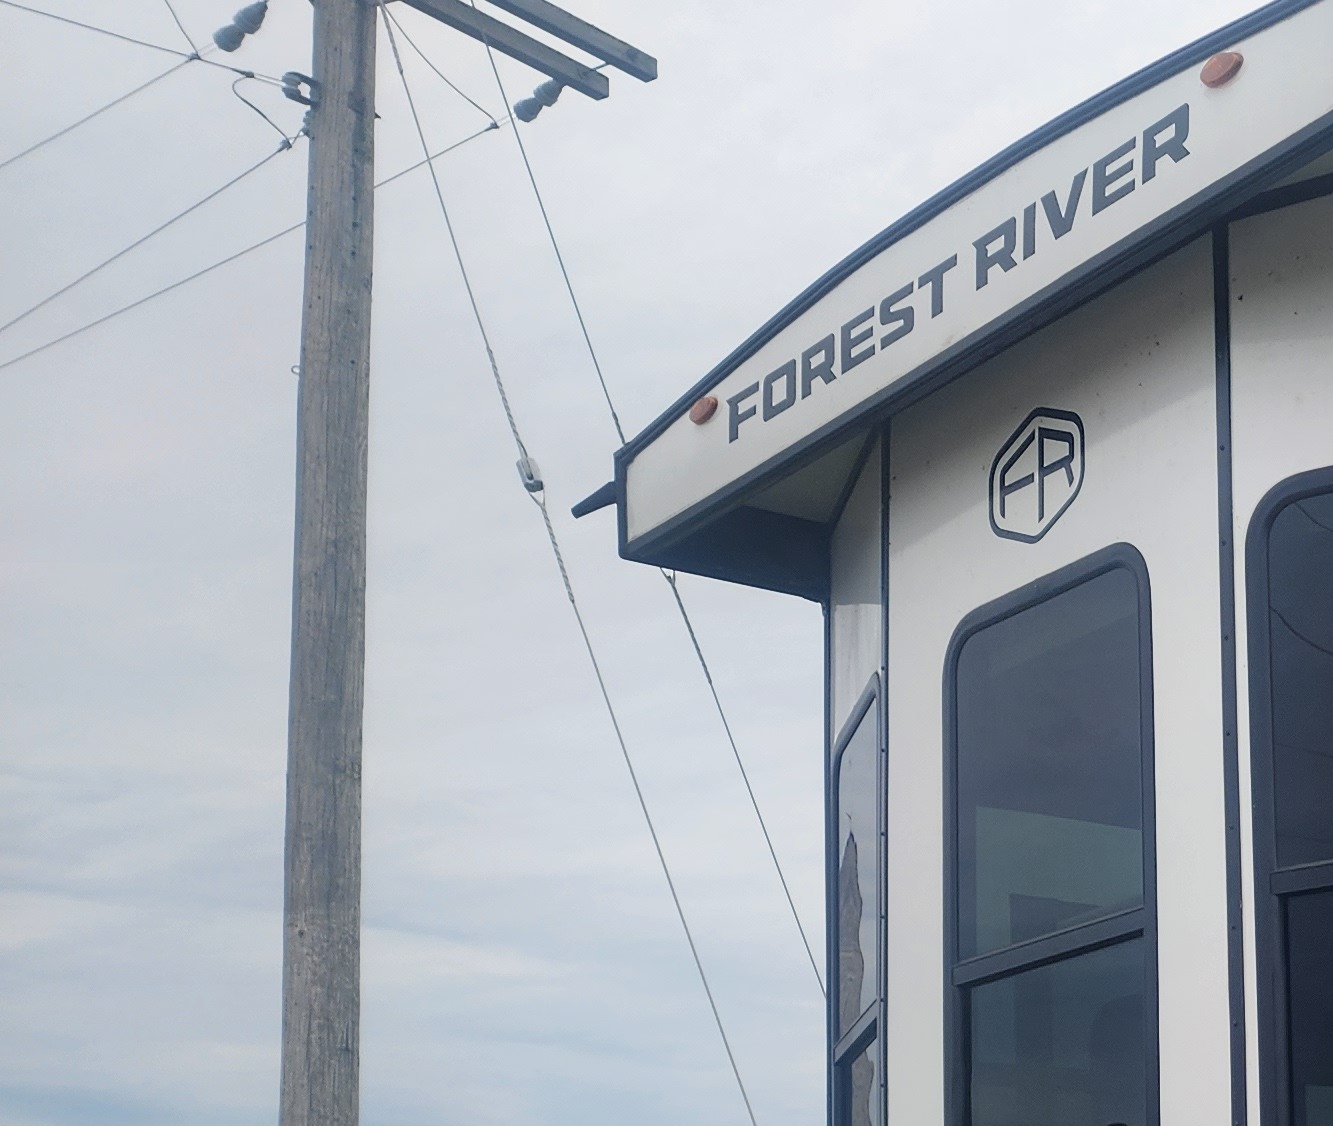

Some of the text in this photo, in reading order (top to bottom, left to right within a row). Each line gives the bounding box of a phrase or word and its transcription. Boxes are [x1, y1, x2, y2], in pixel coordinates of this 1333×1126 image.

[727, 103, 1190, 443] FOREST RIVER
[999, 426, 1074, 524] FR
